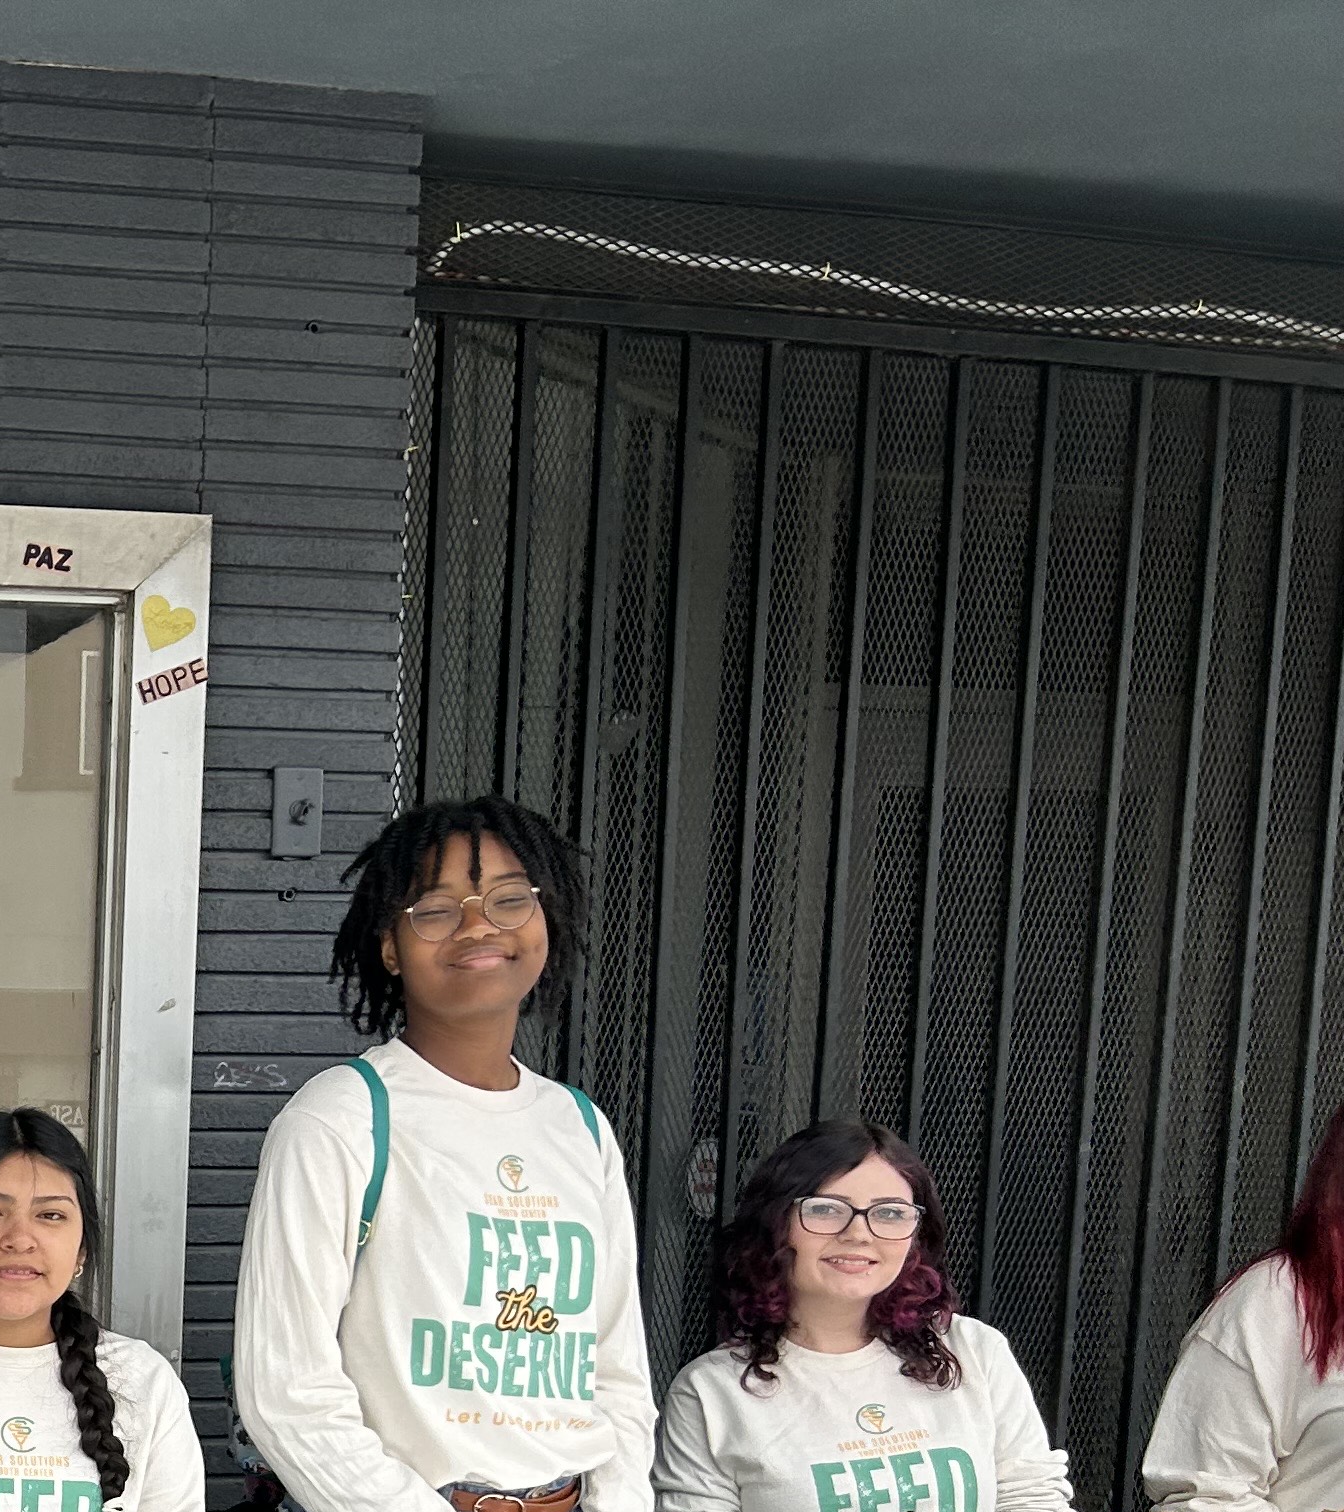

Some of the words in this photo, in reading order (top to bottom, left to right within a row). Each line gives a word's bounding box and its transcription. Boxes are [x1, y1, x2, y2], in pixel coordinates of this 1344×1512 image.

[22, 543, 75, 573] PAZ
[137, 656, 209, 703] HOPE
[463, 1211, 595, 1315] FEED
[496, 1284, 559, 1335] the
[411, 1318, 597, 1401] DESERVE
[445, 1407, 482, 1425] Let
[10, 1454, 70, 1468] SOLUTIONS
